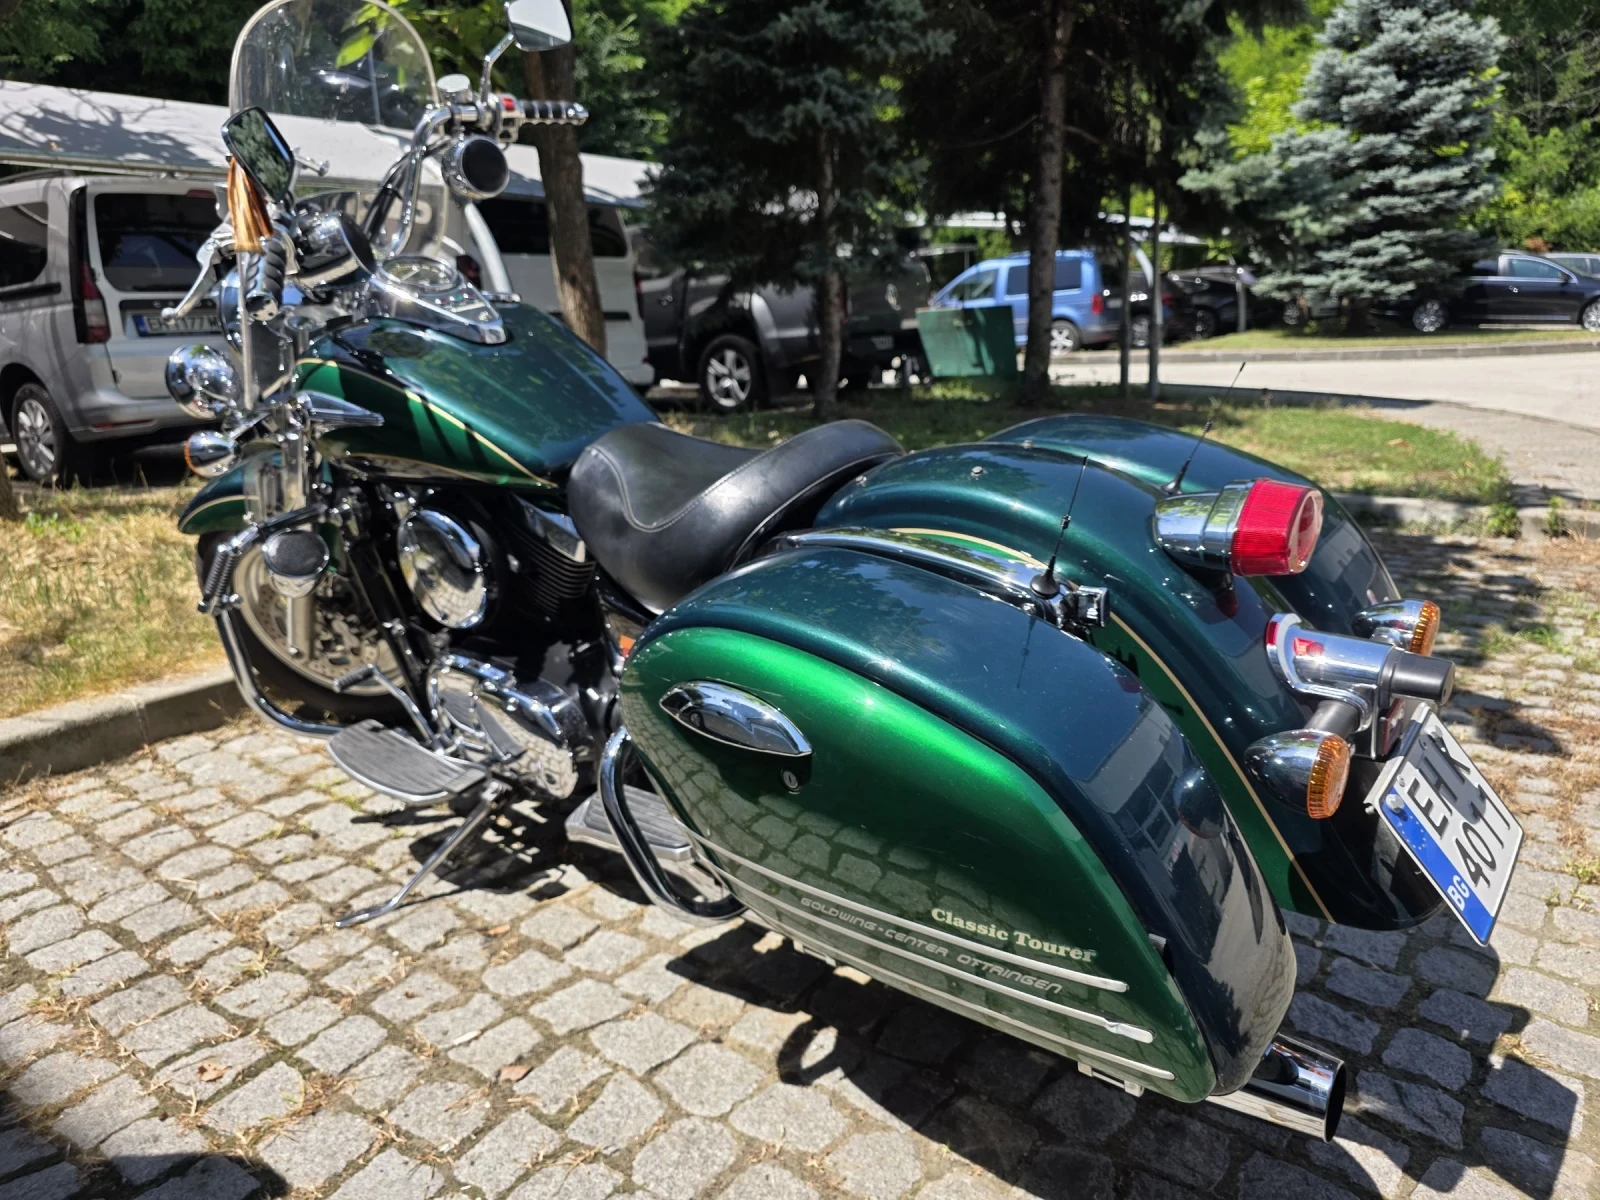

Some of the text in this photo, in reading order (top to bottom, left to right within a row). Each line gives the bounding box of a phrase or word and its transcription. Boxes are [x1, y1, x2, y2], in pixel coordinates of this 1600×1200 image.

[1407, 732, 1471, 839] EHK
[1455, 783, 1511, 888] 4011
[1447, 874, 1470, 912] BG
[931, 906, 1097, 963] Classic Tourer
